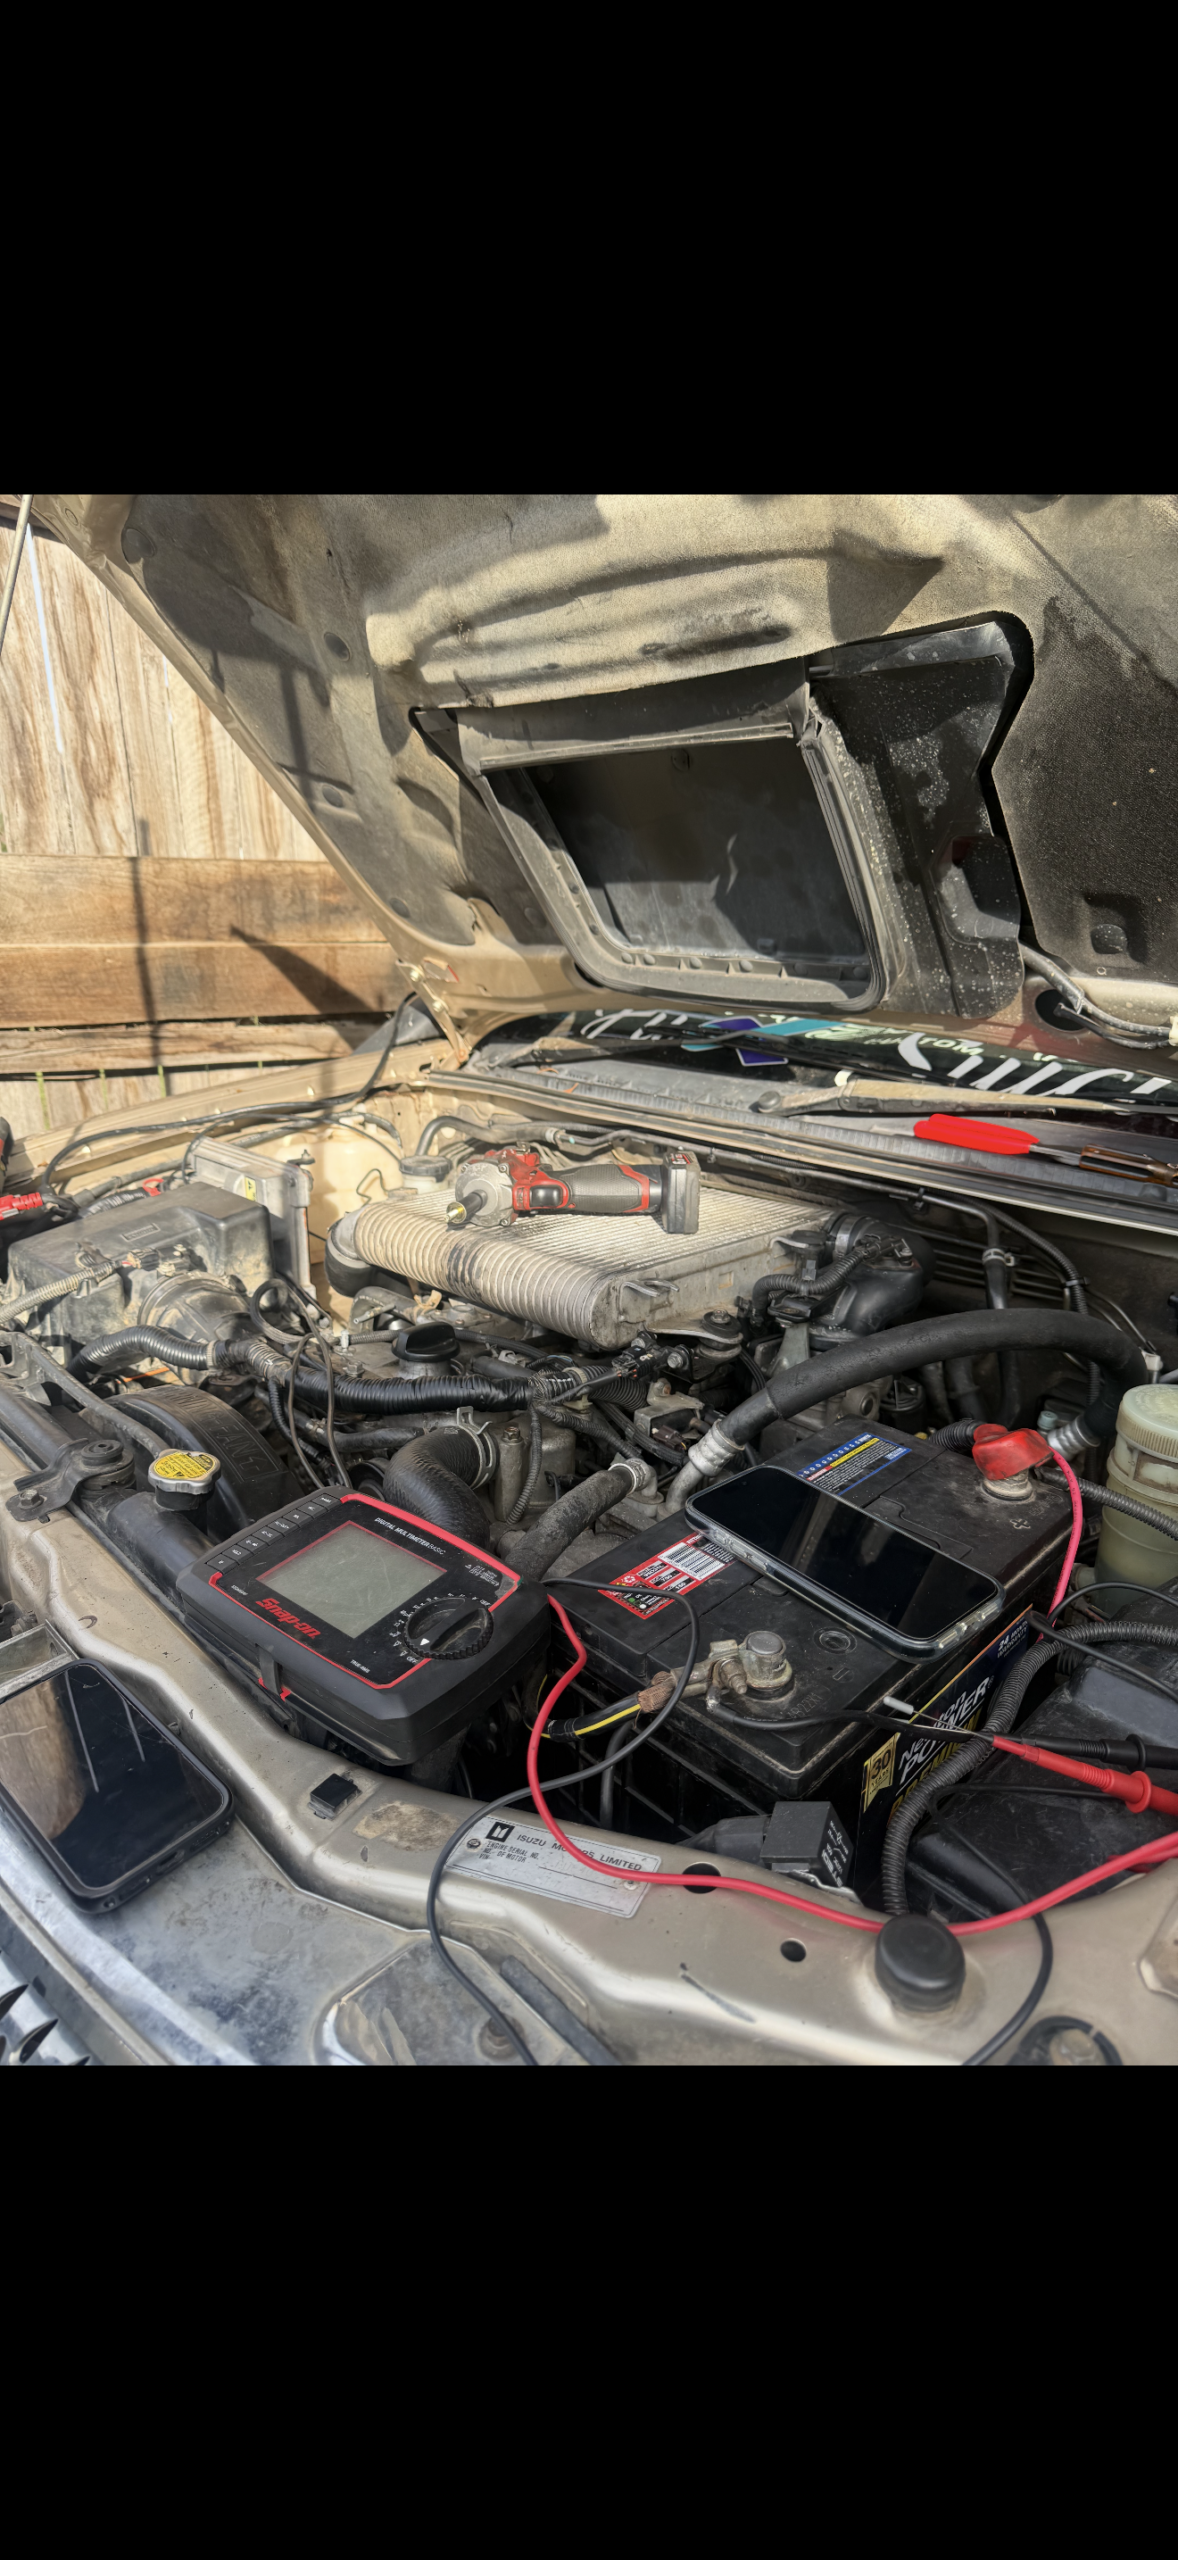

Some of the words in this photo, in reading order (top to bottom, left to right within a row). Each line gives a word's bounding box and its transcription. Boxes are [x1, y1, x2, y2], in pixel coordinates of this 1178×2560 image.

[374, 1517, 395, 1532] DIGITAL
[394, 1526, 430, 1548] MULTIMETER
[255, 1597, 322, 1639] Snap-on
[898, 1691, 967, 1770] Neton
[871, 1751, 892, 1780] 30
[486, 1841, 508, 1851] ENGINE
[507, 1845, 529, 1856] SERIAL
[505, 1852, 527, 1864] MOTOR
[516, 1834, 547, 1848] ISUZU
[552, 1841, 595, 1859] MORS
[599, 1856, 643, 1872] LIMITED
